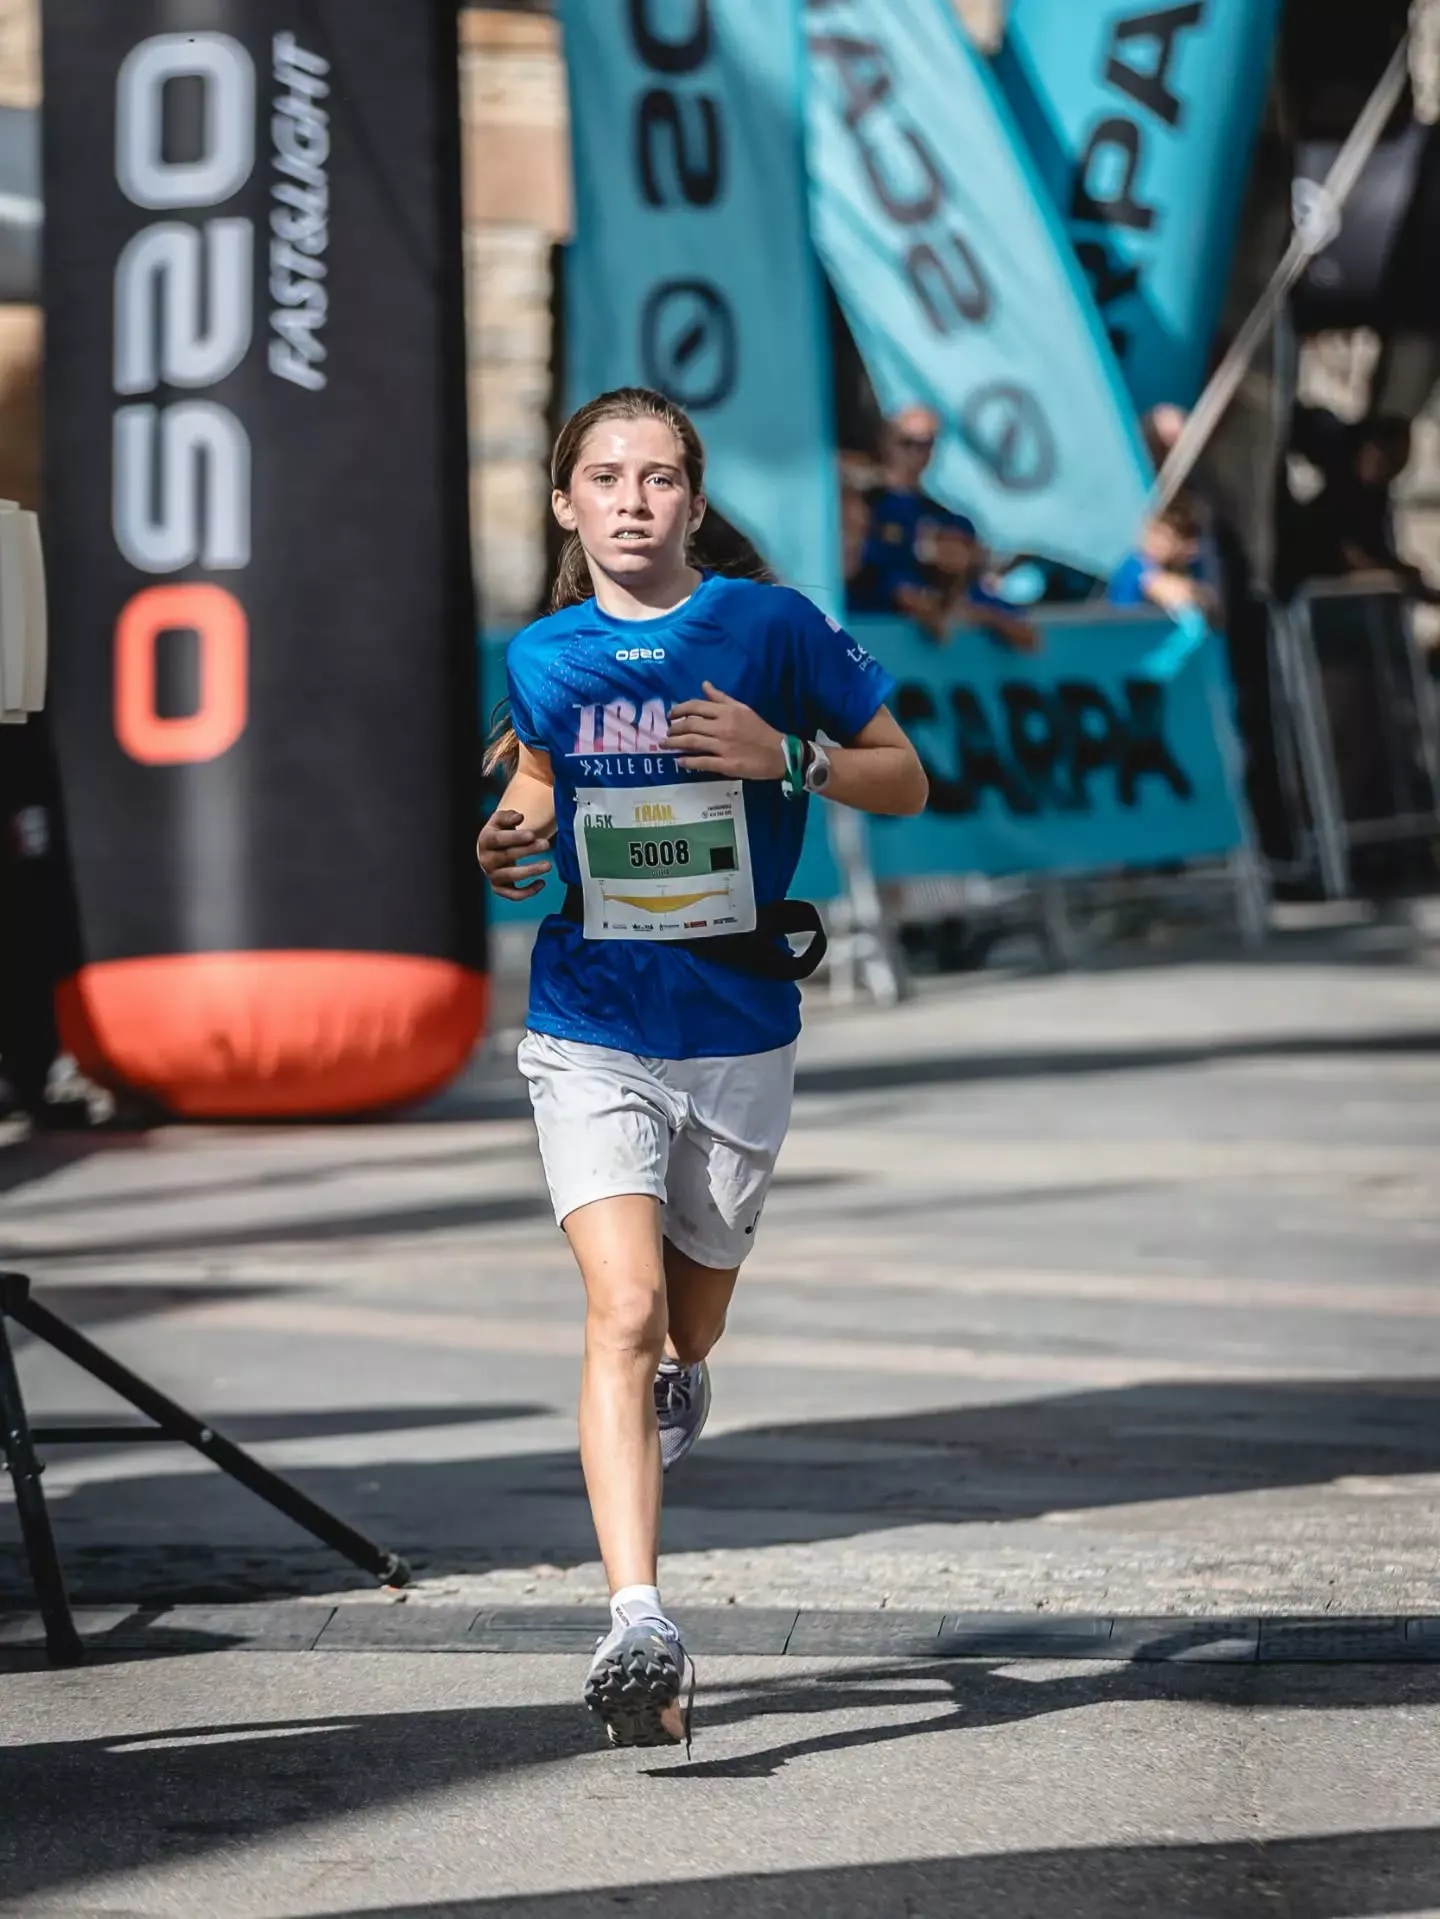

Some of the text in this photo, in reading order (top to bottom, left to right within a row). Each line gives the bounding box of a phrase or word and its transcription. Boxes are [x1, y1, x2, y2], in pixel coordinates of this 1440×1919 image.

[268, 30, 331, 392] FAST&LIGHT
[643, 757, 665, 774] DE
[583, 814, 614, 829] 0.5K
[628, 838, 690, 868] 5008
